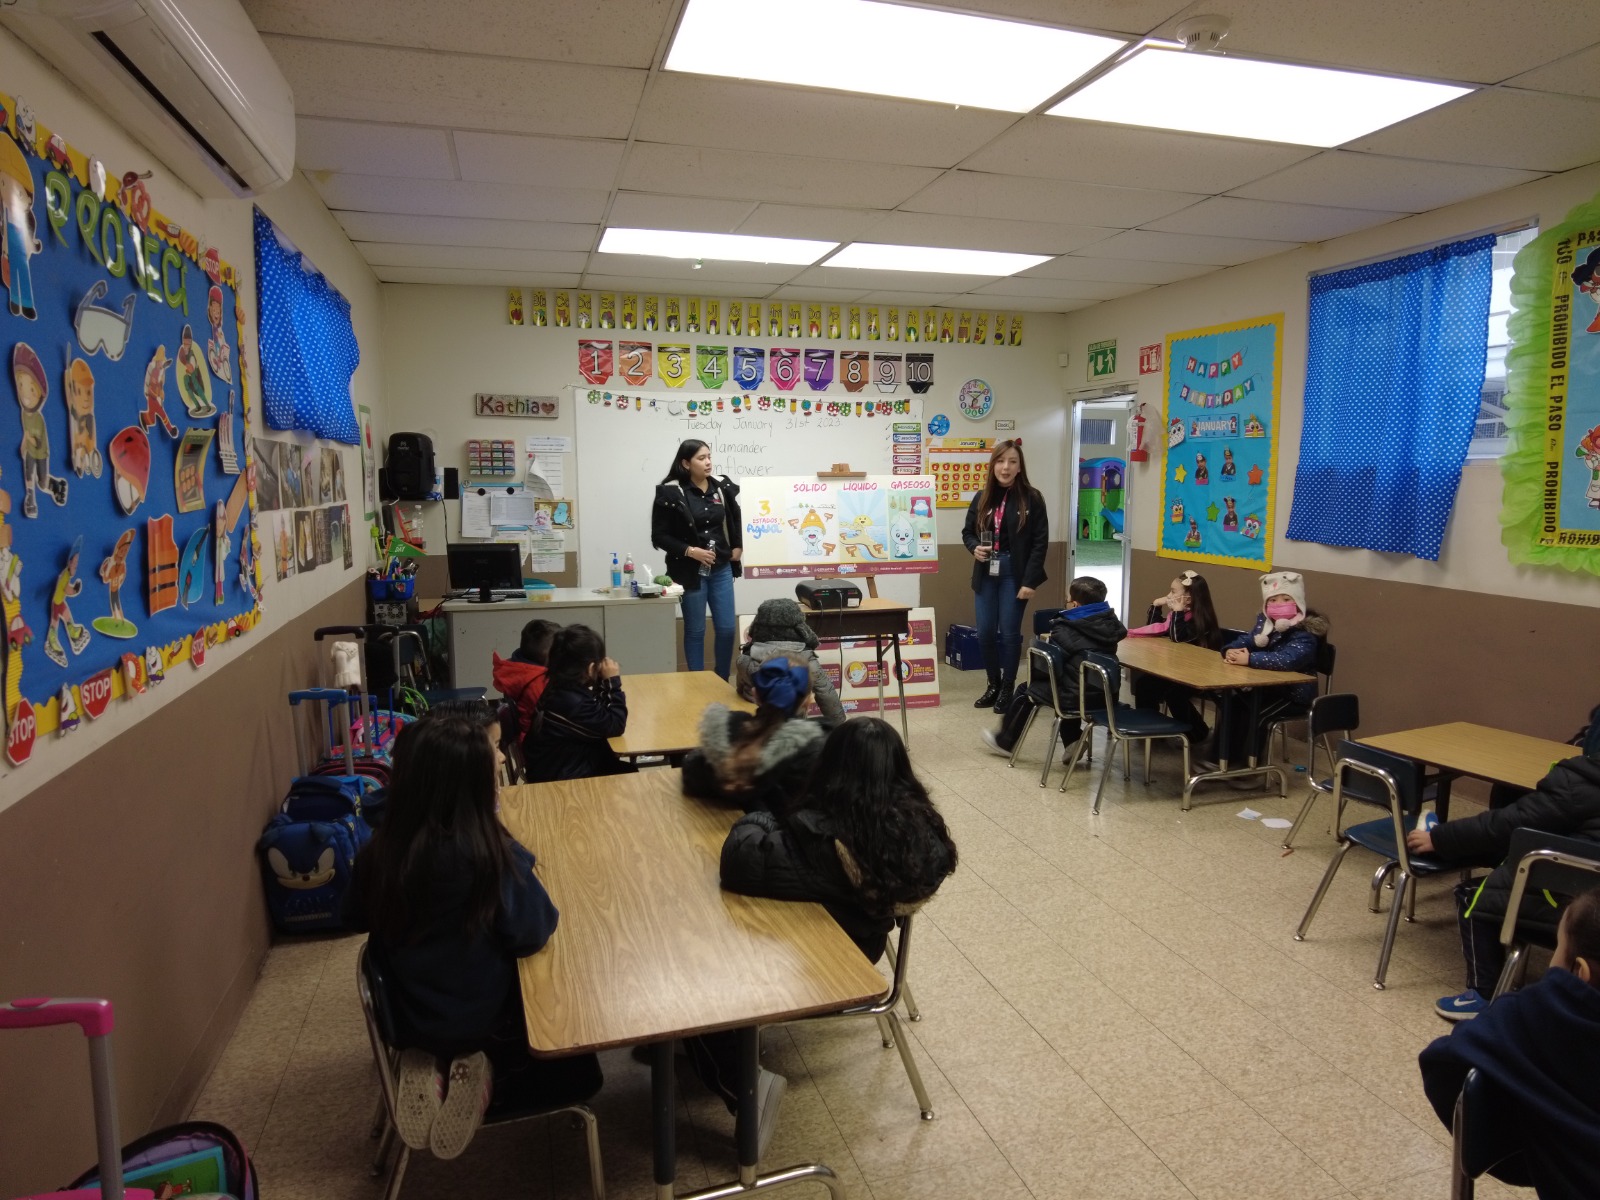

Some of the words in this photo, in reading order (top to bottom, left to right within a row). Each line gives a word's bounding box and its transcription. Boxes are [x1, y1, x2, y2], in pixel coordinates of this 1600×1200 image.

[46, 171, 188, 317] PROJECT
[205, 257, 220, 275] STOP
[1550, 294, 1570, 369] PROHIBIDO
[590, 350, 602, 376] 1
[626, 351, 644, 376] 2
[666, 354, 683, 378] 3
[703, 356, 722, 380] 4
[740, 357, 757, 381] 5
[776, 357, 794, 382] 6
[810, 358, 828, 382] 7
[846, 360, 862, 384] 8
[879, 361, 896, 385] 9
[908, 362, 931, 382] 10
[1187, 354, 1240, 376] HAPPY
[1181, 379, 1252, 406] BIRTHDAY
[1550, 374, 1564, 390] EL
[480, 396, 540, 414] Kathia
[1548, 396, 1563, 431] PASO
[680, 418, 723, 435] Tuesday
[732, 416, 773, 438] January
[785, 417, 810, 430] 31st
[816, 417, 841, 428] 2023
[1196, 420, 1232, 431] JANUARY
[793, 482, 828, 492] SÓLIDO
[843, 480, 878, 491] LÍQUIDO
[890, 480, 930, 490] GASEOSO
[758, 500, 771, 516] 3
[1544, 461, 1559, 533] PROHIBIDO
[82, 678, 110, 704] STOP
[8, 716, 35, 748] STOP
